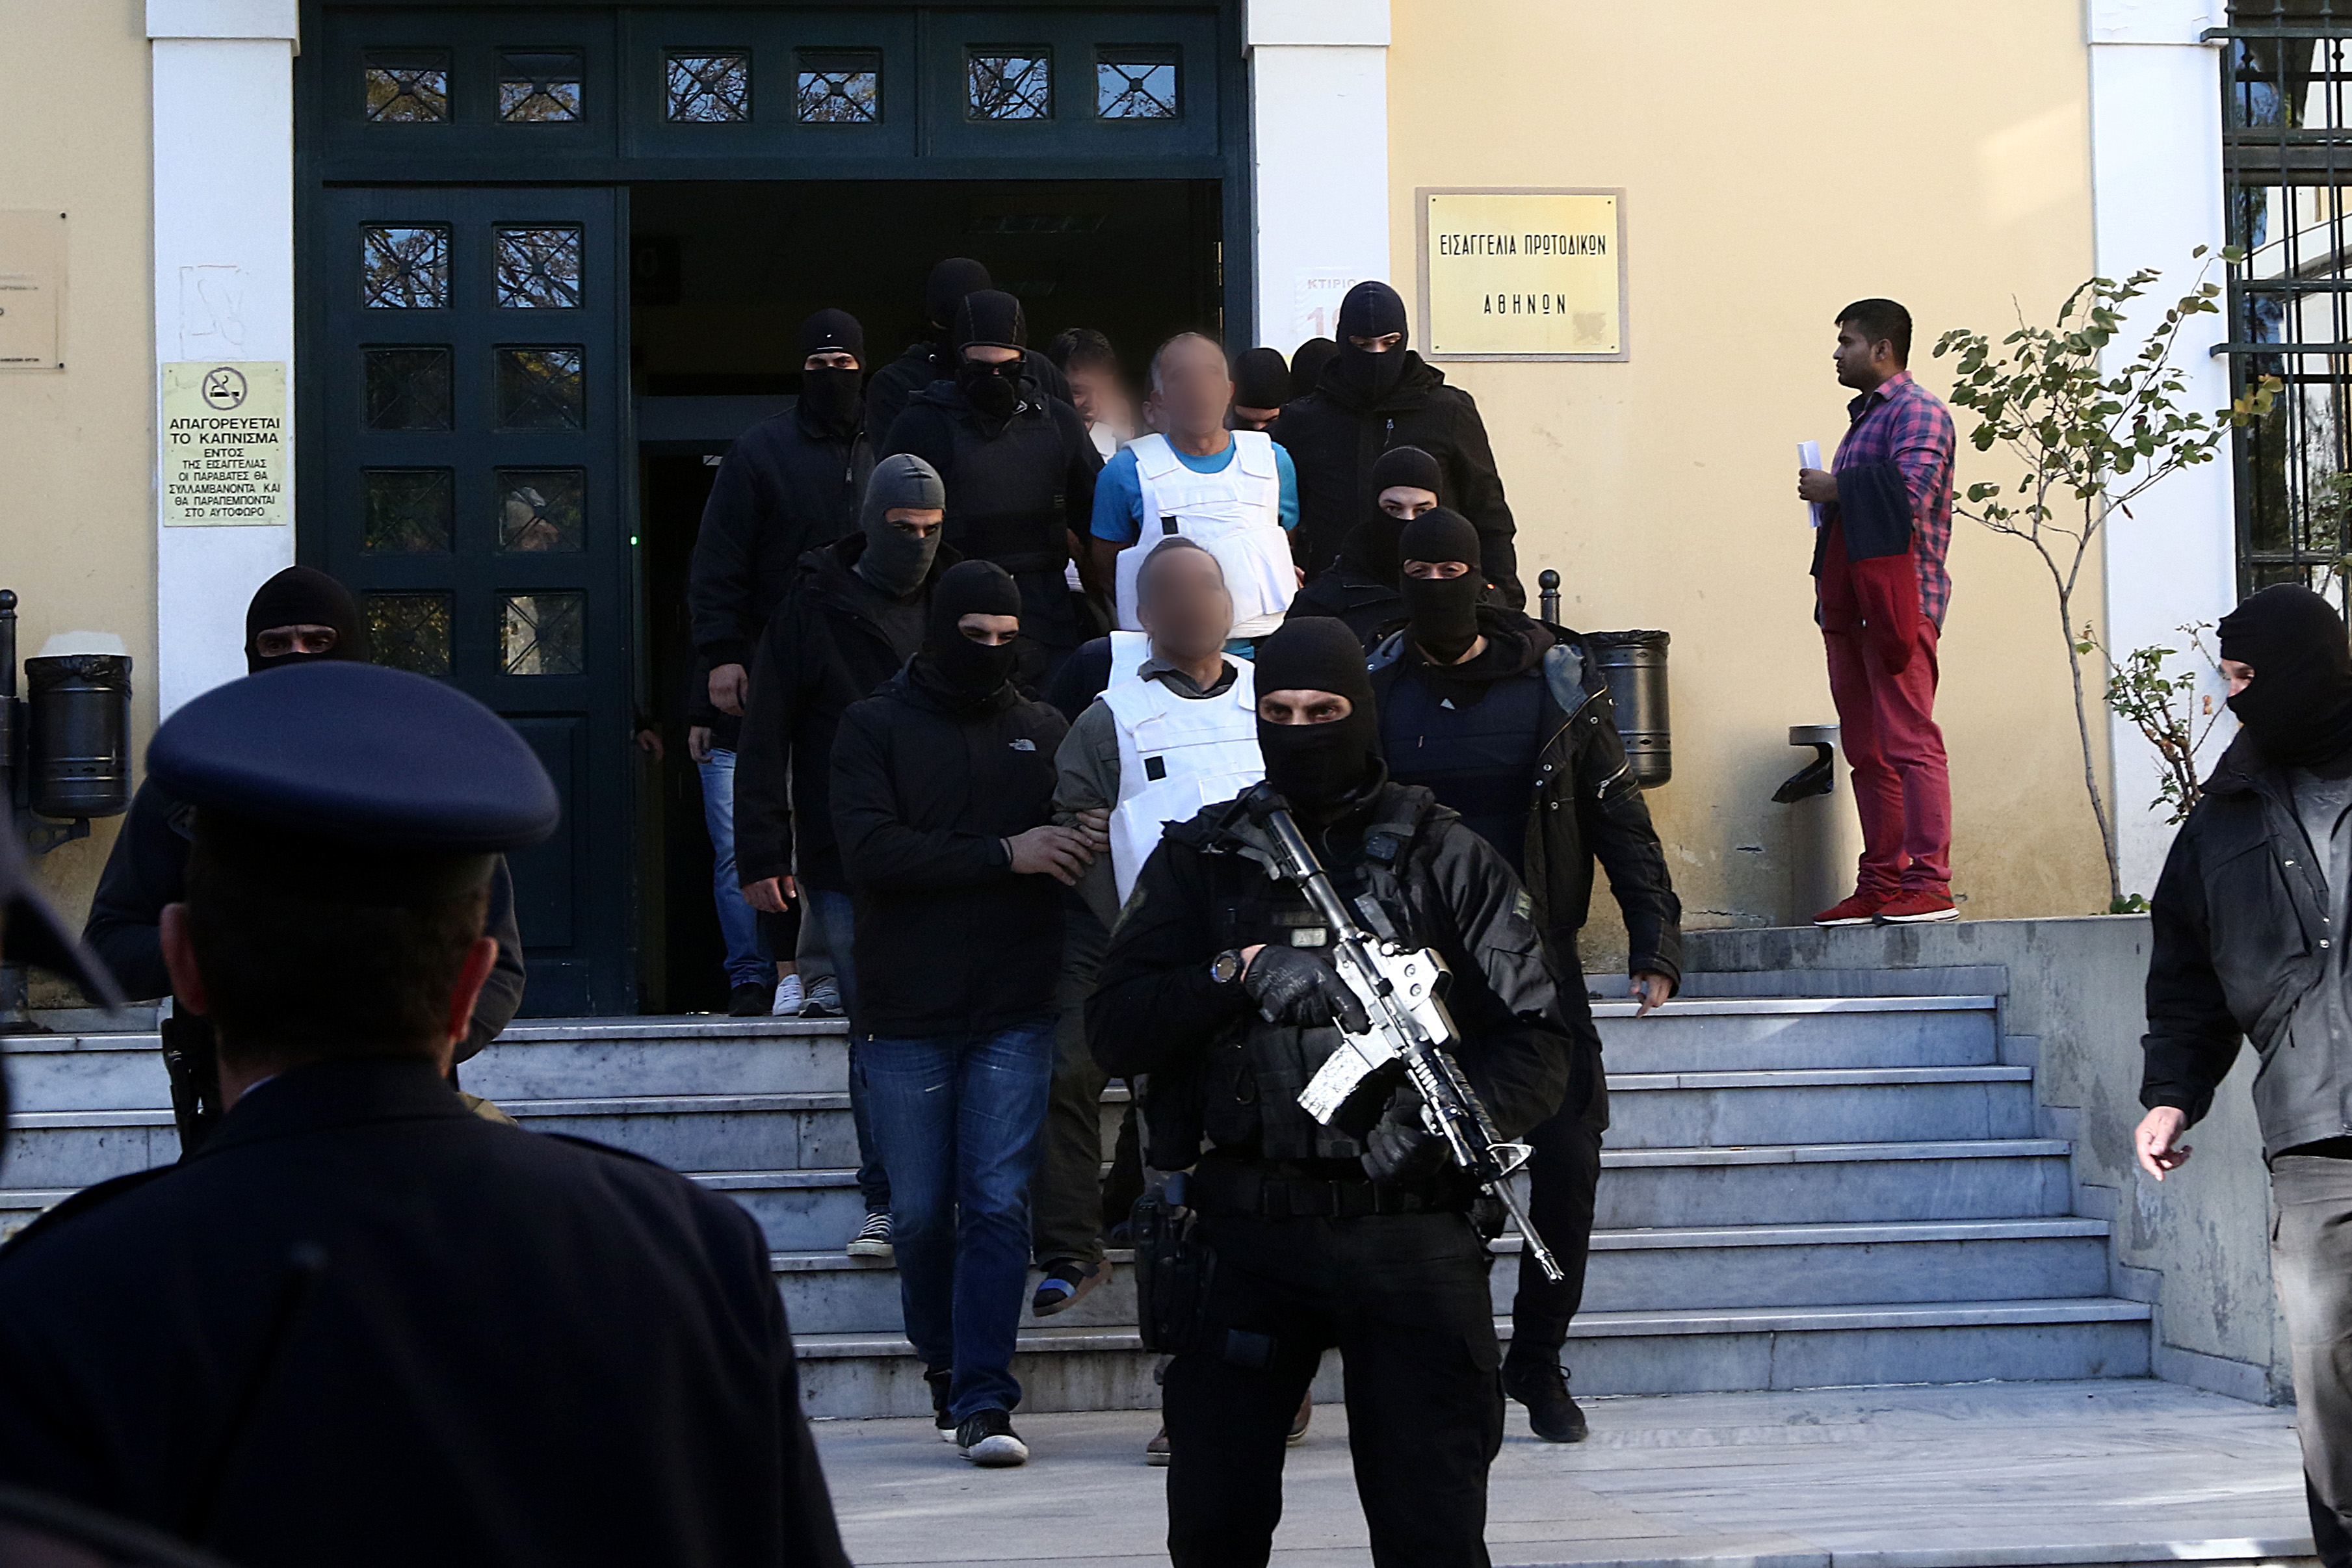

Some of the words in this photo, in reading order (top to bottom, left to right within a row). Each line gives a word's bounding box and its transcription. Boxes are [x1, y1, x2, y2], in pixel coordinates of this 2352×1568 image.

[1441, 235, 1516, 255] ΕΙΣΑΓΓΕΛΙΑ
[1525, 235, 1605, 255] ΠΡΩΤΟΔΙΚΩΝ
[1484, 294, 1565, 314] ΑΘΗΝΩΝ
[170, 418, 280, 429] ΑΠΑΓΟΡΕΥΕΤΑΙ
[170, 433, 190, 444] ΤΟ
[200, 433, 278, 443] ΚΑΠΝΙΣΜΑ
[204, 449, 244, 458] ΕΝΤΟΣ
[183, 460, 201, 469] ΤΗΣ
[207, 459, 267, 469] ΕΙΣΑΓΓΕΛΙΑΣ
[179, 473, 188, 481] ΟΙ
[194, 471, 249, 480] ΠΑΡΑΒΑΤΕΣ
[254, 471, 267, 480] ΘΑ
[264, 484, 280, 492] ΚΑΙ
[175, 497, 188, 506] ΘΑ
[194, 496, 274, 505] ΠΑΡΑΠΕΜΠΟΝΤΑΙ
[185, 508, 204, 517] ΣΤΟ
[210, 507, 265, 517] ΑΥΤΟΦΩΡΟ
